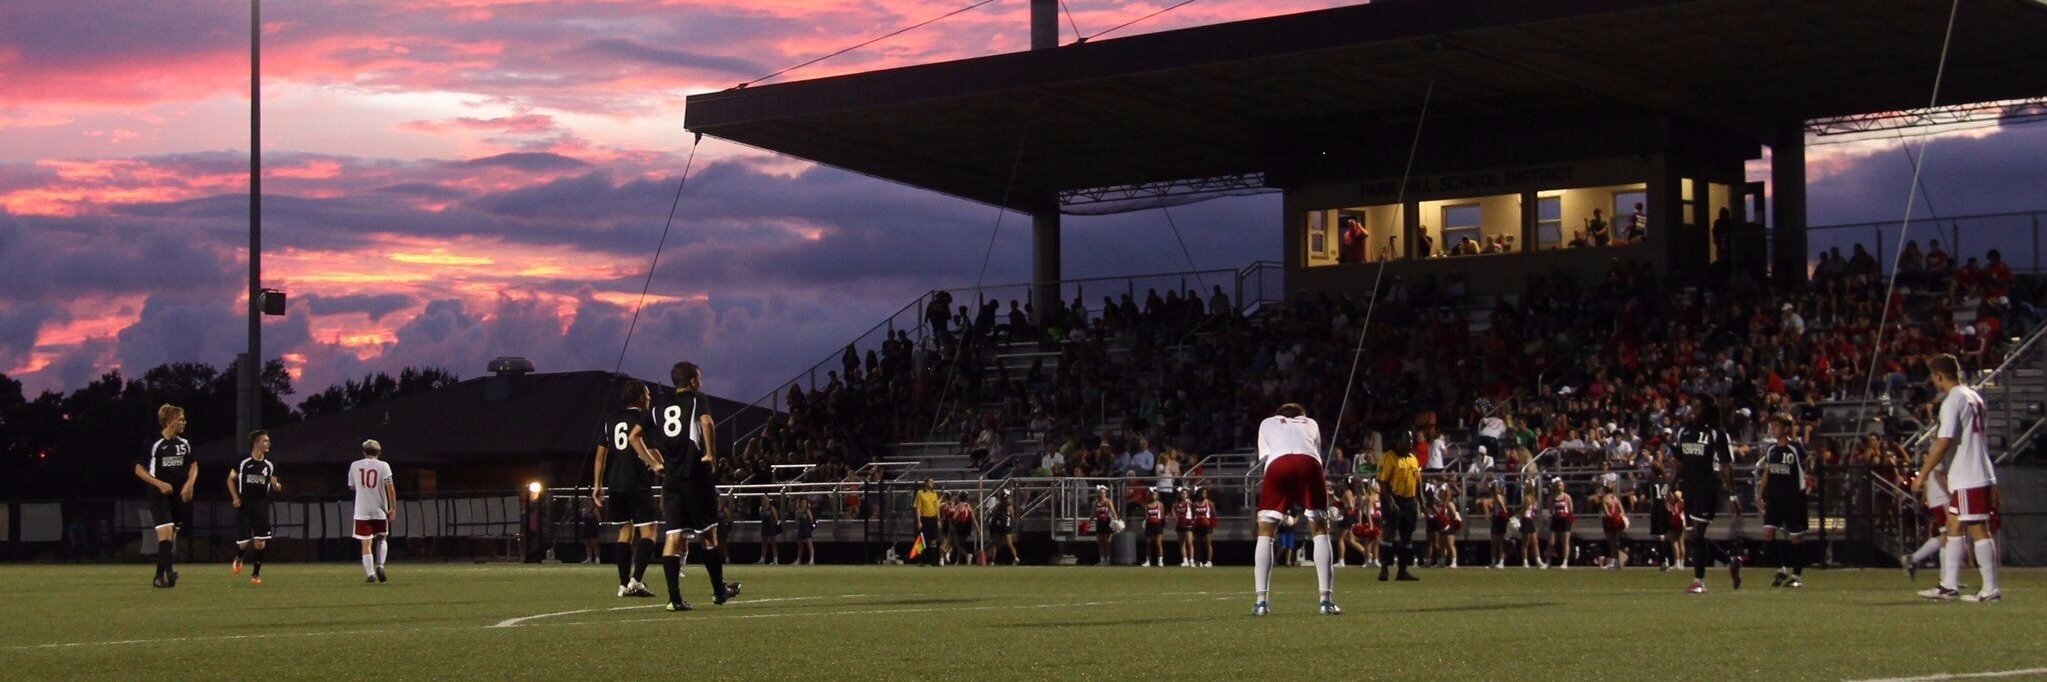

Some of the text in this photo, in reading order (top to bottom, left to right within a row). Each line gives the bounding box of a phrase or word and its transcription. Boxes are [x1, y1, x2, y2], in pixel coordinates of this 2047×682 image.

[1440, 172, 1499, 191] SCHOOL
[1505, 166, 1575, 187] DISTRICT
[663, 405, 682, 437] 8
[614, 422, 628, 450] 6
[175, 444, 187, 456] 15
[1781, 452, 1794, 465] 10
[261, 466, 269, 477] 4
[358, 468, 378, 488] 10
